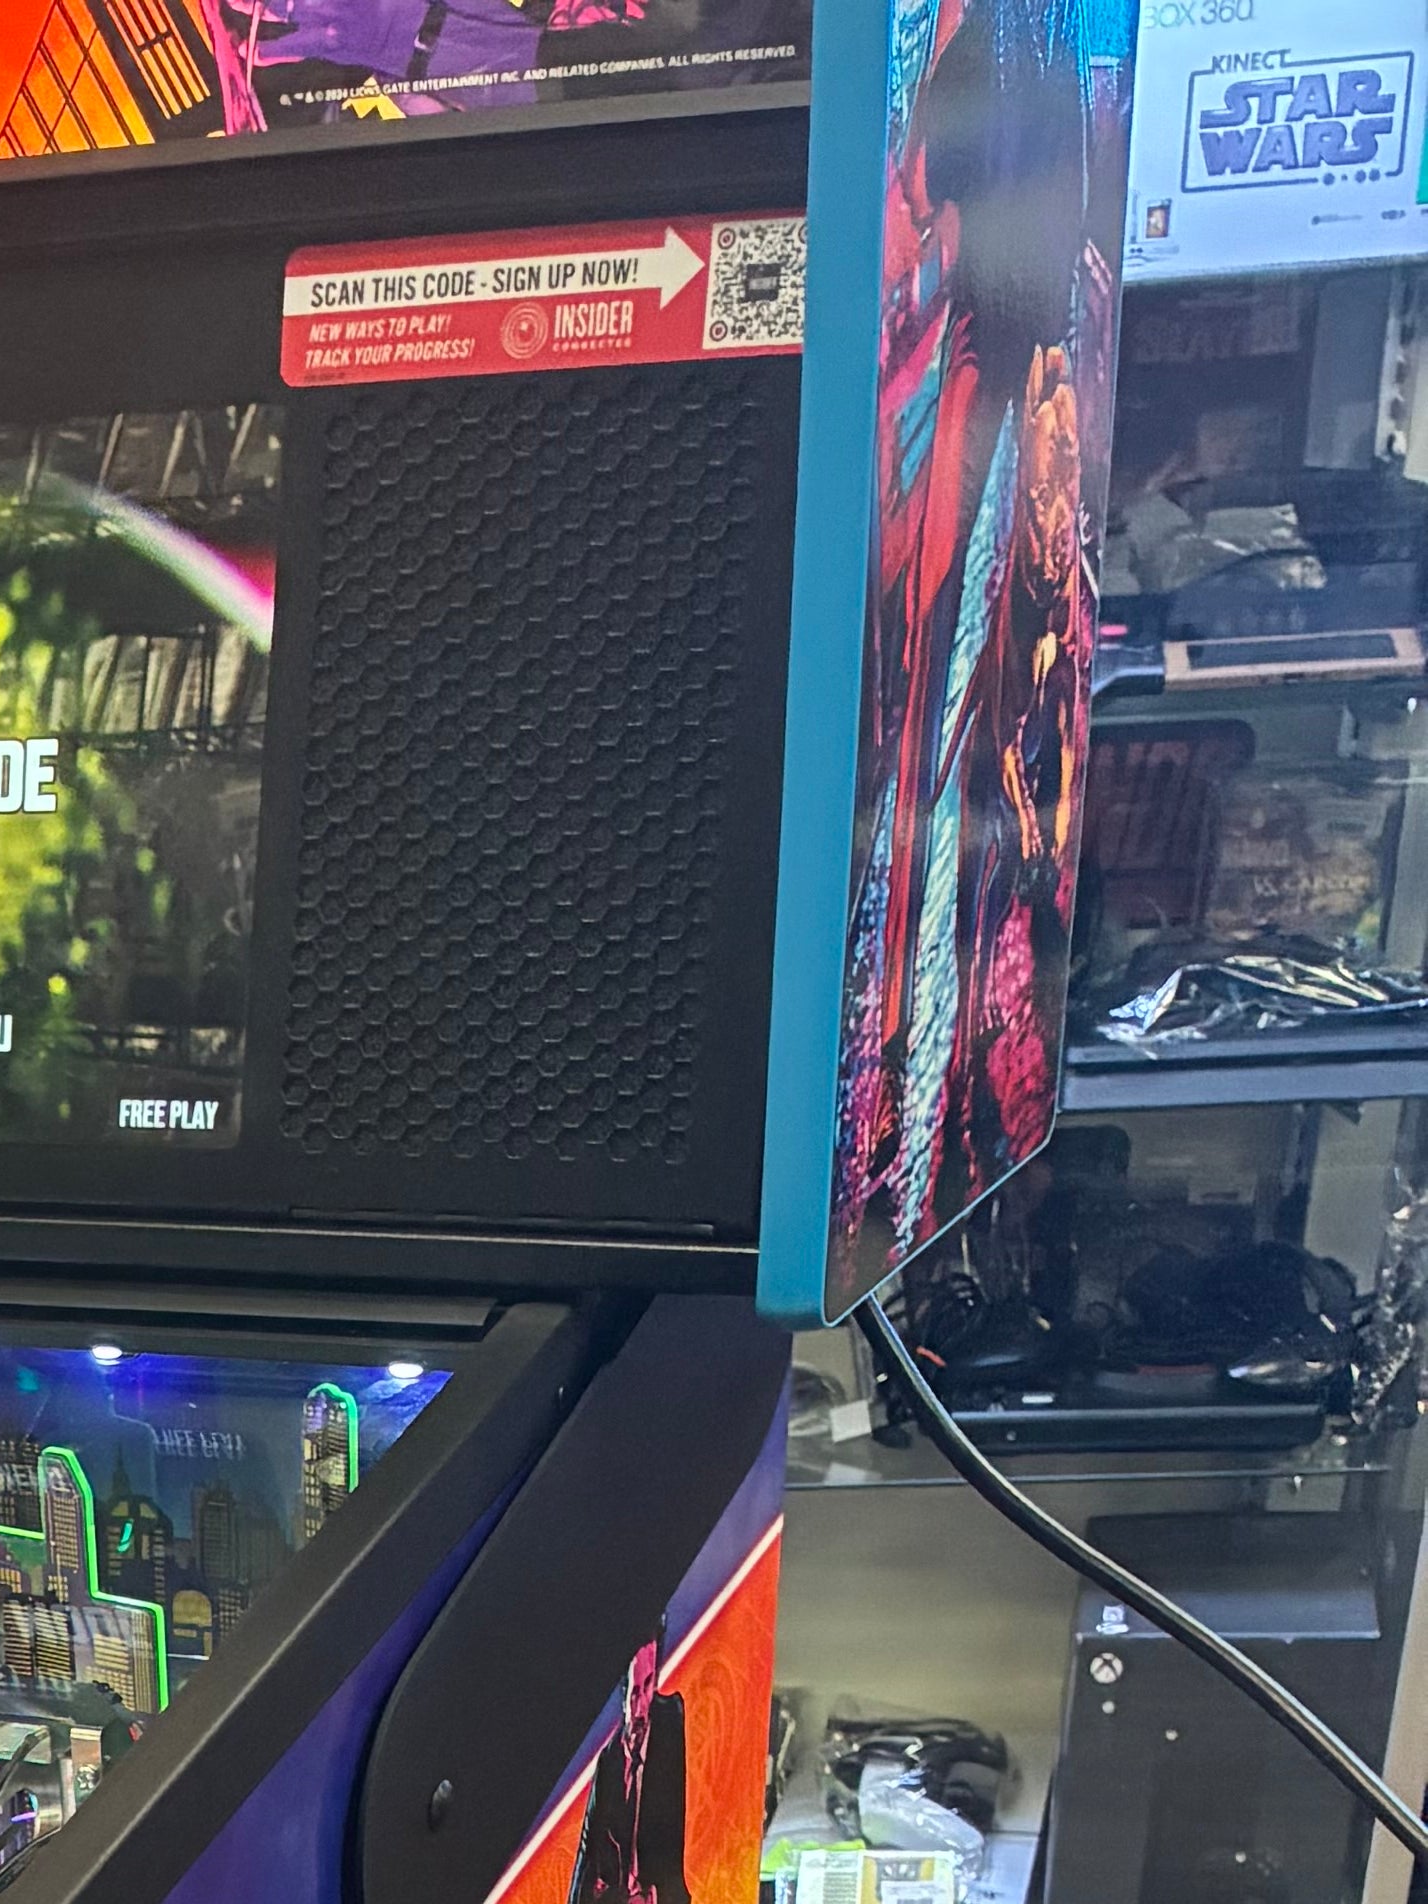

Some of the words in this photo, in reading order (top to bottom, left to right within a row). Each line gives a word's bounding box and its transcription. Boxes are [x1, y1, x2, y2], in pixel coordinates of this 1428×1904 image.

[1145, 8, 1195, 29] BOX
[548, 63, 598, 78] RELATED
[668, 55, 689, 67] ALL
[692, 50, 732, 64] RIGHTS
[1211, 49, 1291, 74] KINECT
[1200, 70, 1396, 129] STAR
[1199, 117, 1393, 176] WARS
[311, 278, 365, 308] SCAN
[372, 275, 417, 303] THIS
[423, 270, 476, 299] CODE
[492, 265, 542, 294] SIGN
[548, 262, 576, 289] UP
[581, 258, 639, 287] NOW!
[309, 323, 342, 342] NEW
[345, 318, 386, 340] WAYS
[388, 317, 407, 337] TO
[409, 314, 452, 335] PLAY!
[554, 300, 634, 339] INSIDER
[305, 349, 352, 368] TRACK
[355, 344, 393, 365] YOUR
[394, 338, 476, 362] PROGRESS!
[118, 1099, 166, 1128] FREE
[169, 1100, 218, 1131] PLAY
